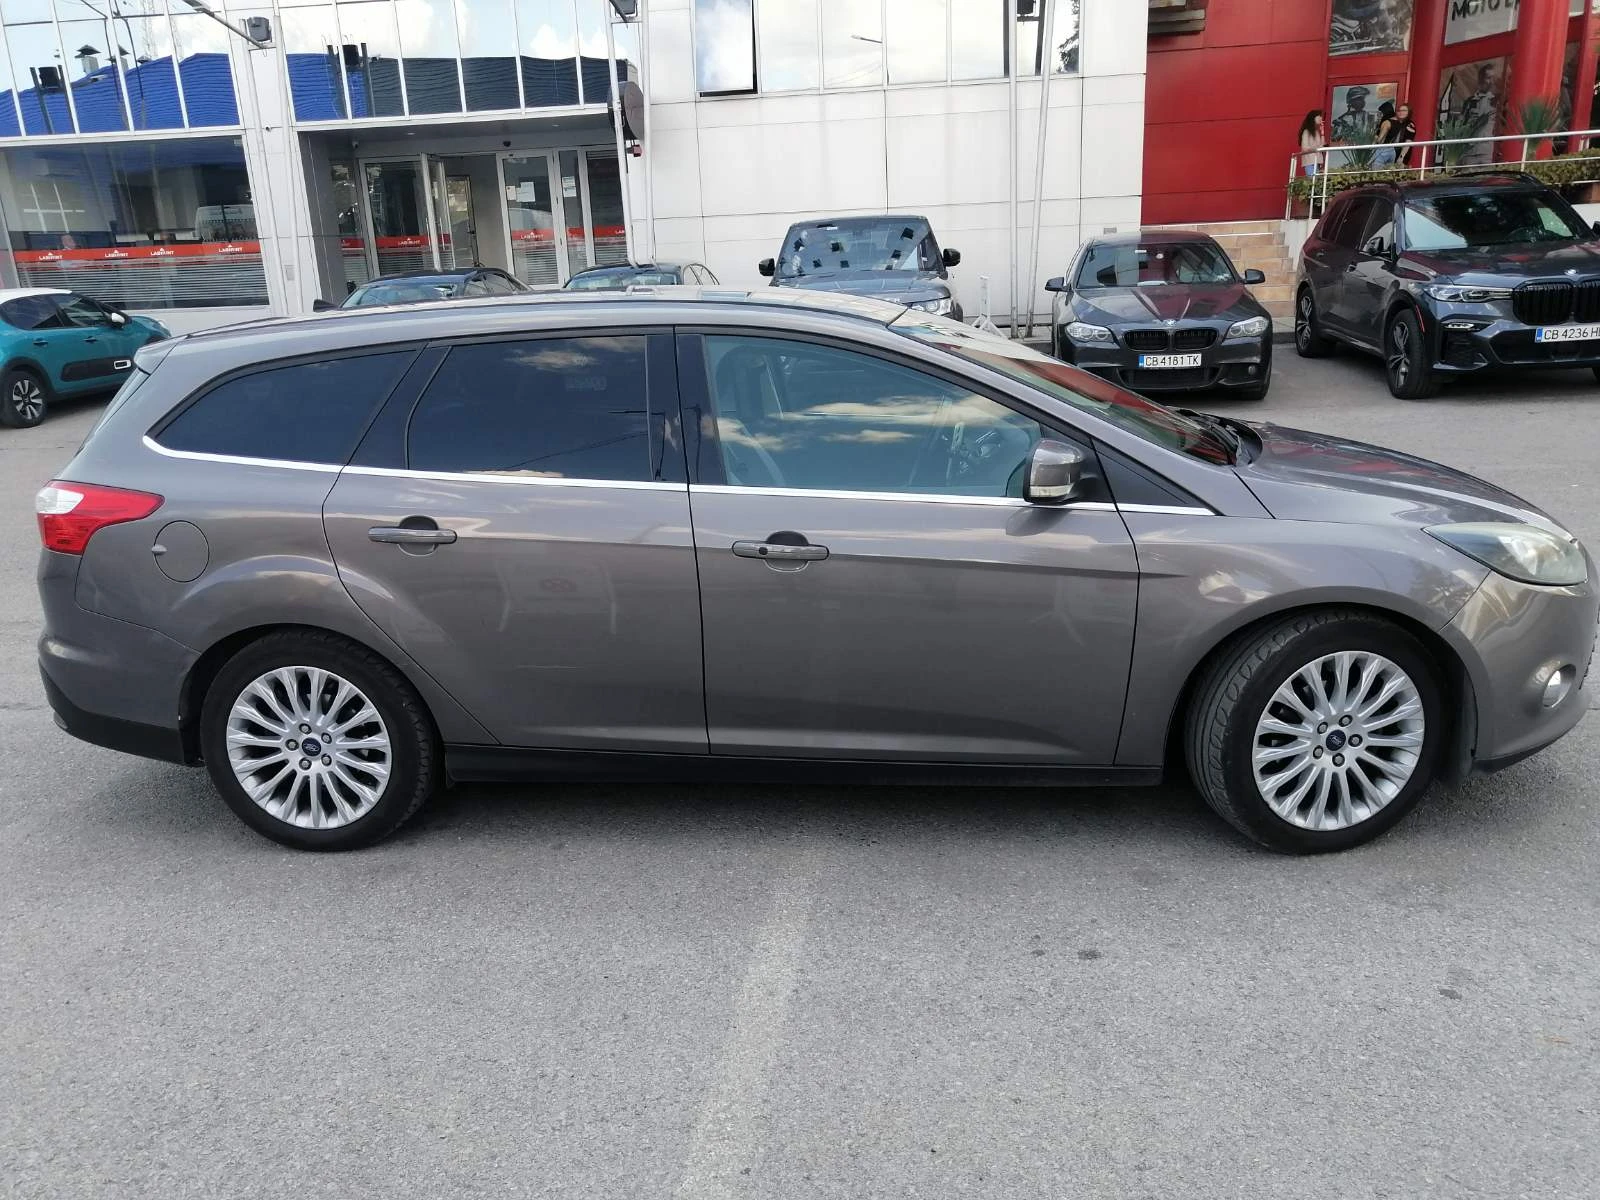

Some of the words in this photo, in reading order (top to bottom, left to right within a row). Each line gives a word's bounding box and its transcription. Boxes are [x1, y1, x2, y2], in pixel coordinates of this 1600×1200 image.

[1544, 329, 1559, 340] CB
[1561, 327, 1589, 339] 4236
[1590, 326, 1600, 338] H
[1145, 356, 1159, 367] CB
[1159, 356, 1184, 366] 4181
[1186, 355, 1199, 365] TK
